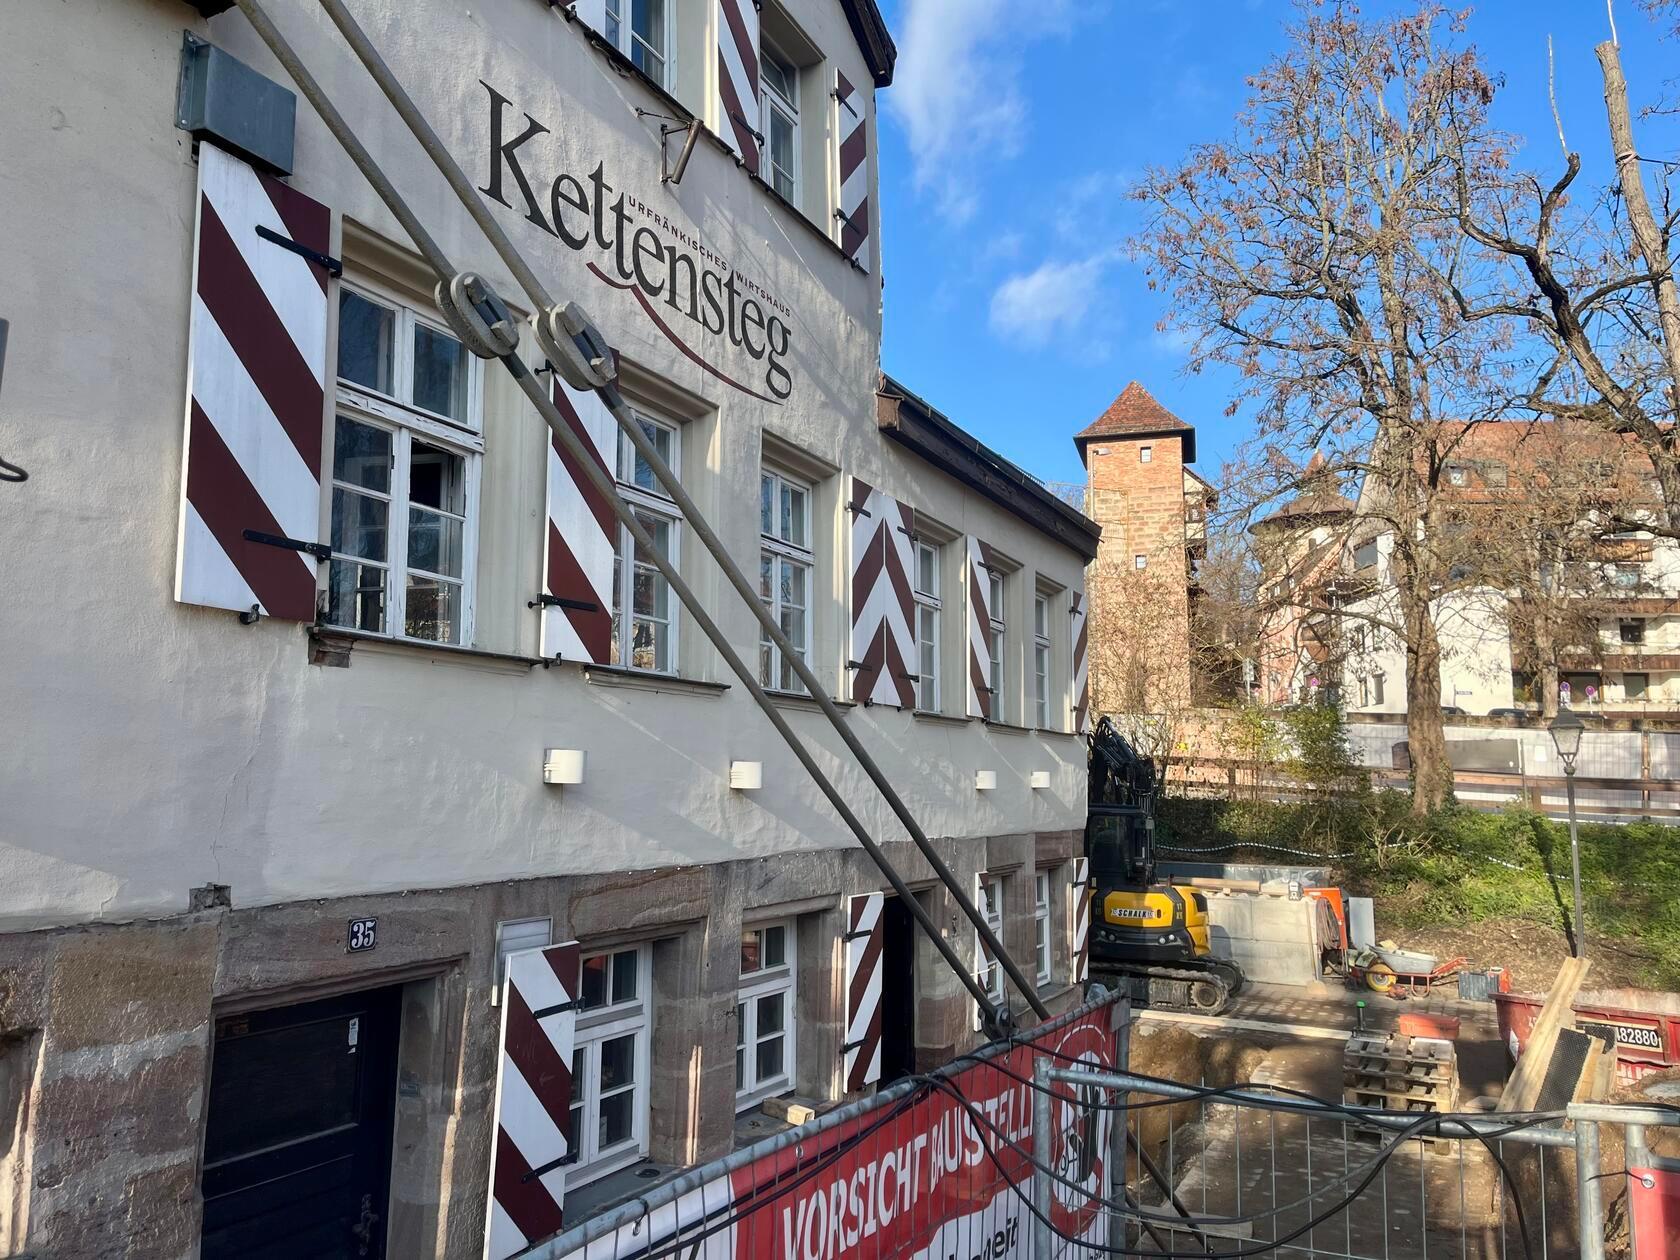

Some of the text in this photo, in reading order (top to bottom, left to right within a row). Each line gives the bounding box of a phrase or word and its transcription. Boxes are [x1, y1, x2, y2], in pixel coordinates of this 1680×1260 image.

[478, 79, 793, 400] Kettensteg
[628, 195, 791, 318] URFRÄNKISCHES WIRTSHAUS
[351, 921, 376, 949] 35
[1118, 909, 1147, 918] SCHALK
[783, 1076, 1035, 1260] VORSICHT BAUSTELL
